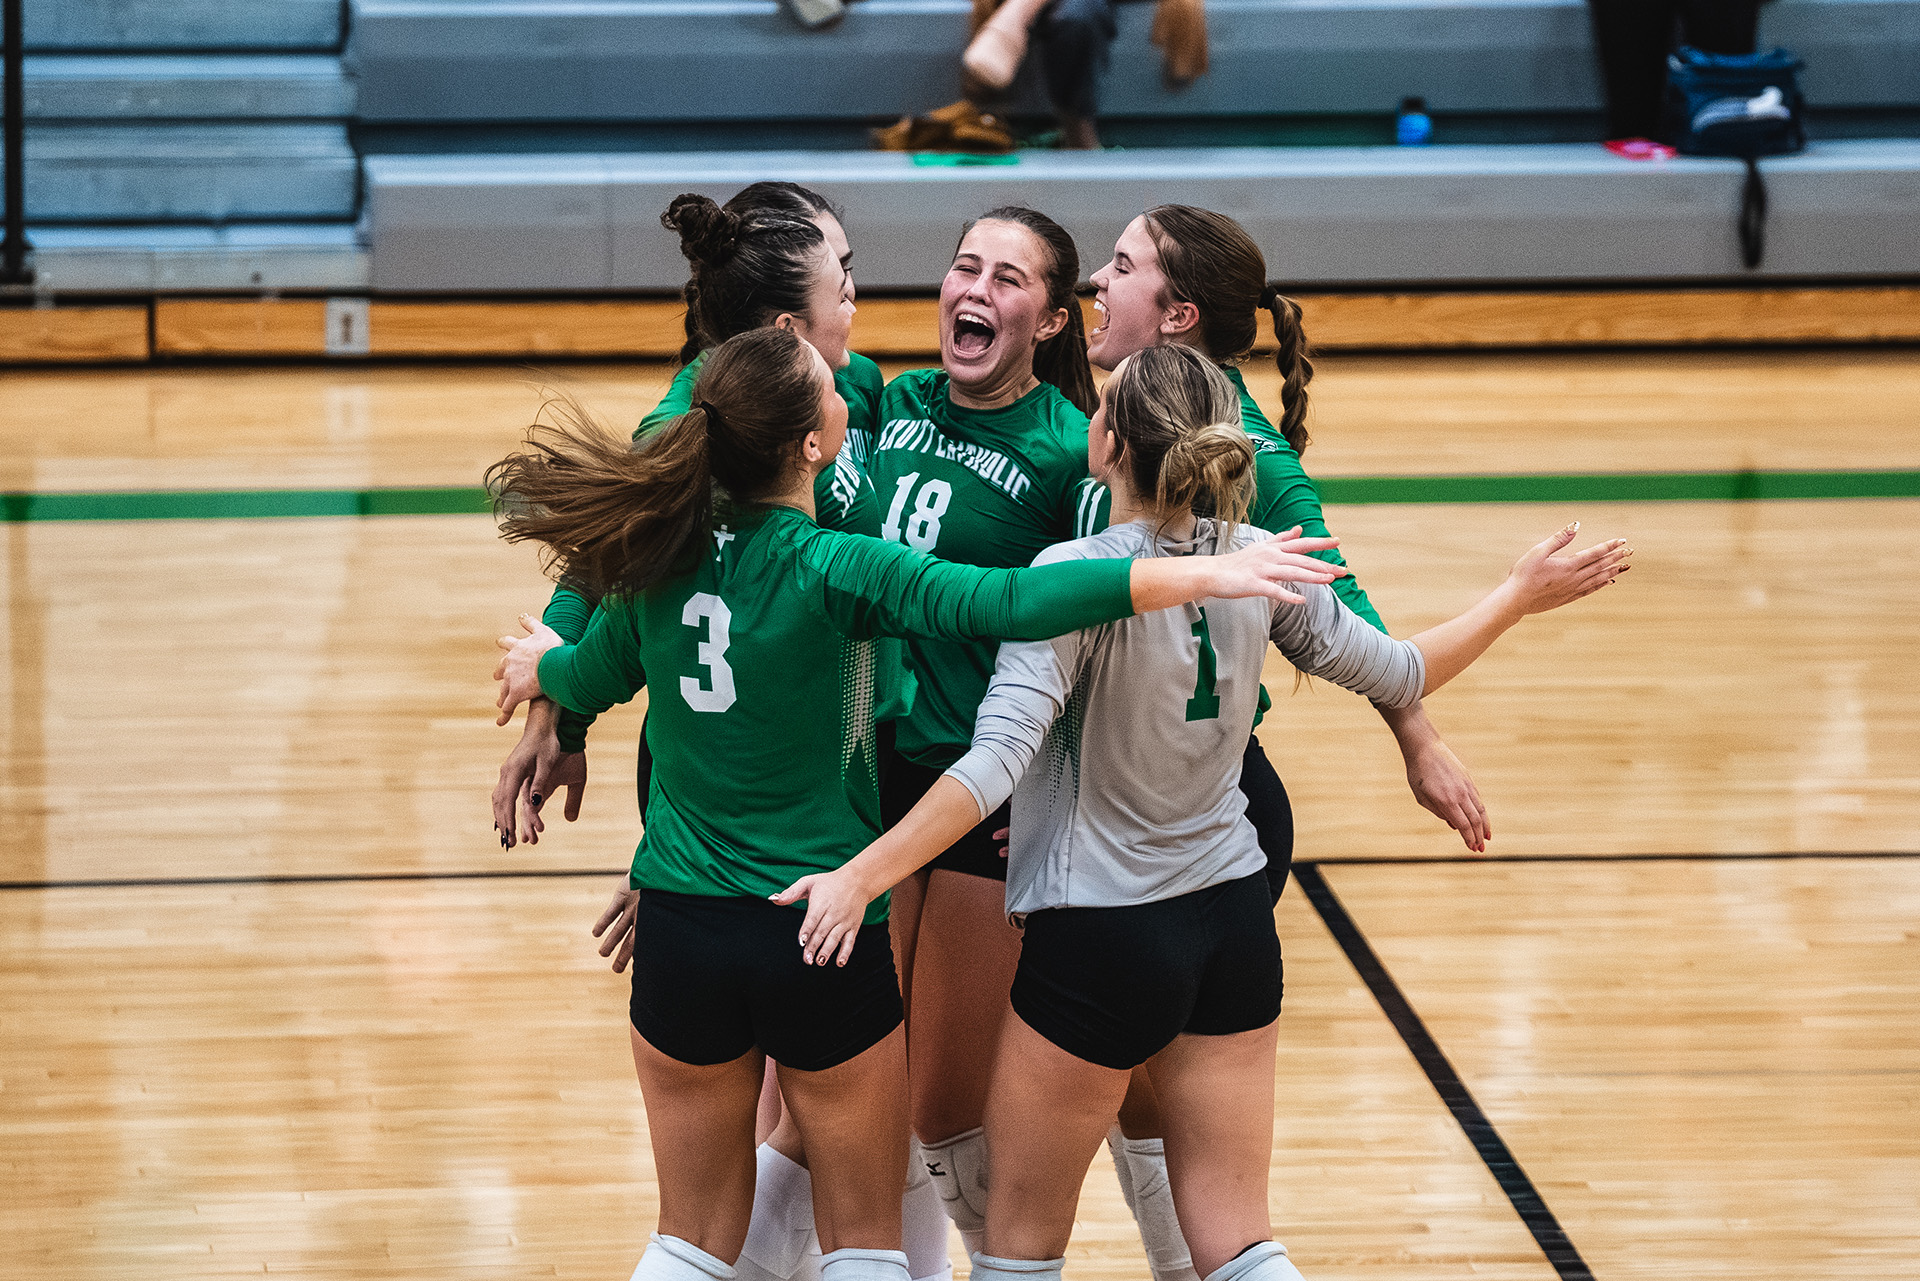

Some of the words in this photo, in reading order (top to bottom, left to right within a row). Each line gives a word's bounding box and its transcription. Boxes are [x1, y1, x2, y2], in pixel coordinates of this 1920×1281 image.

[882, 471, 952, 553] 18
[680, 591, 737, 713] 3
[1185, 606, 1221, 722] 1
